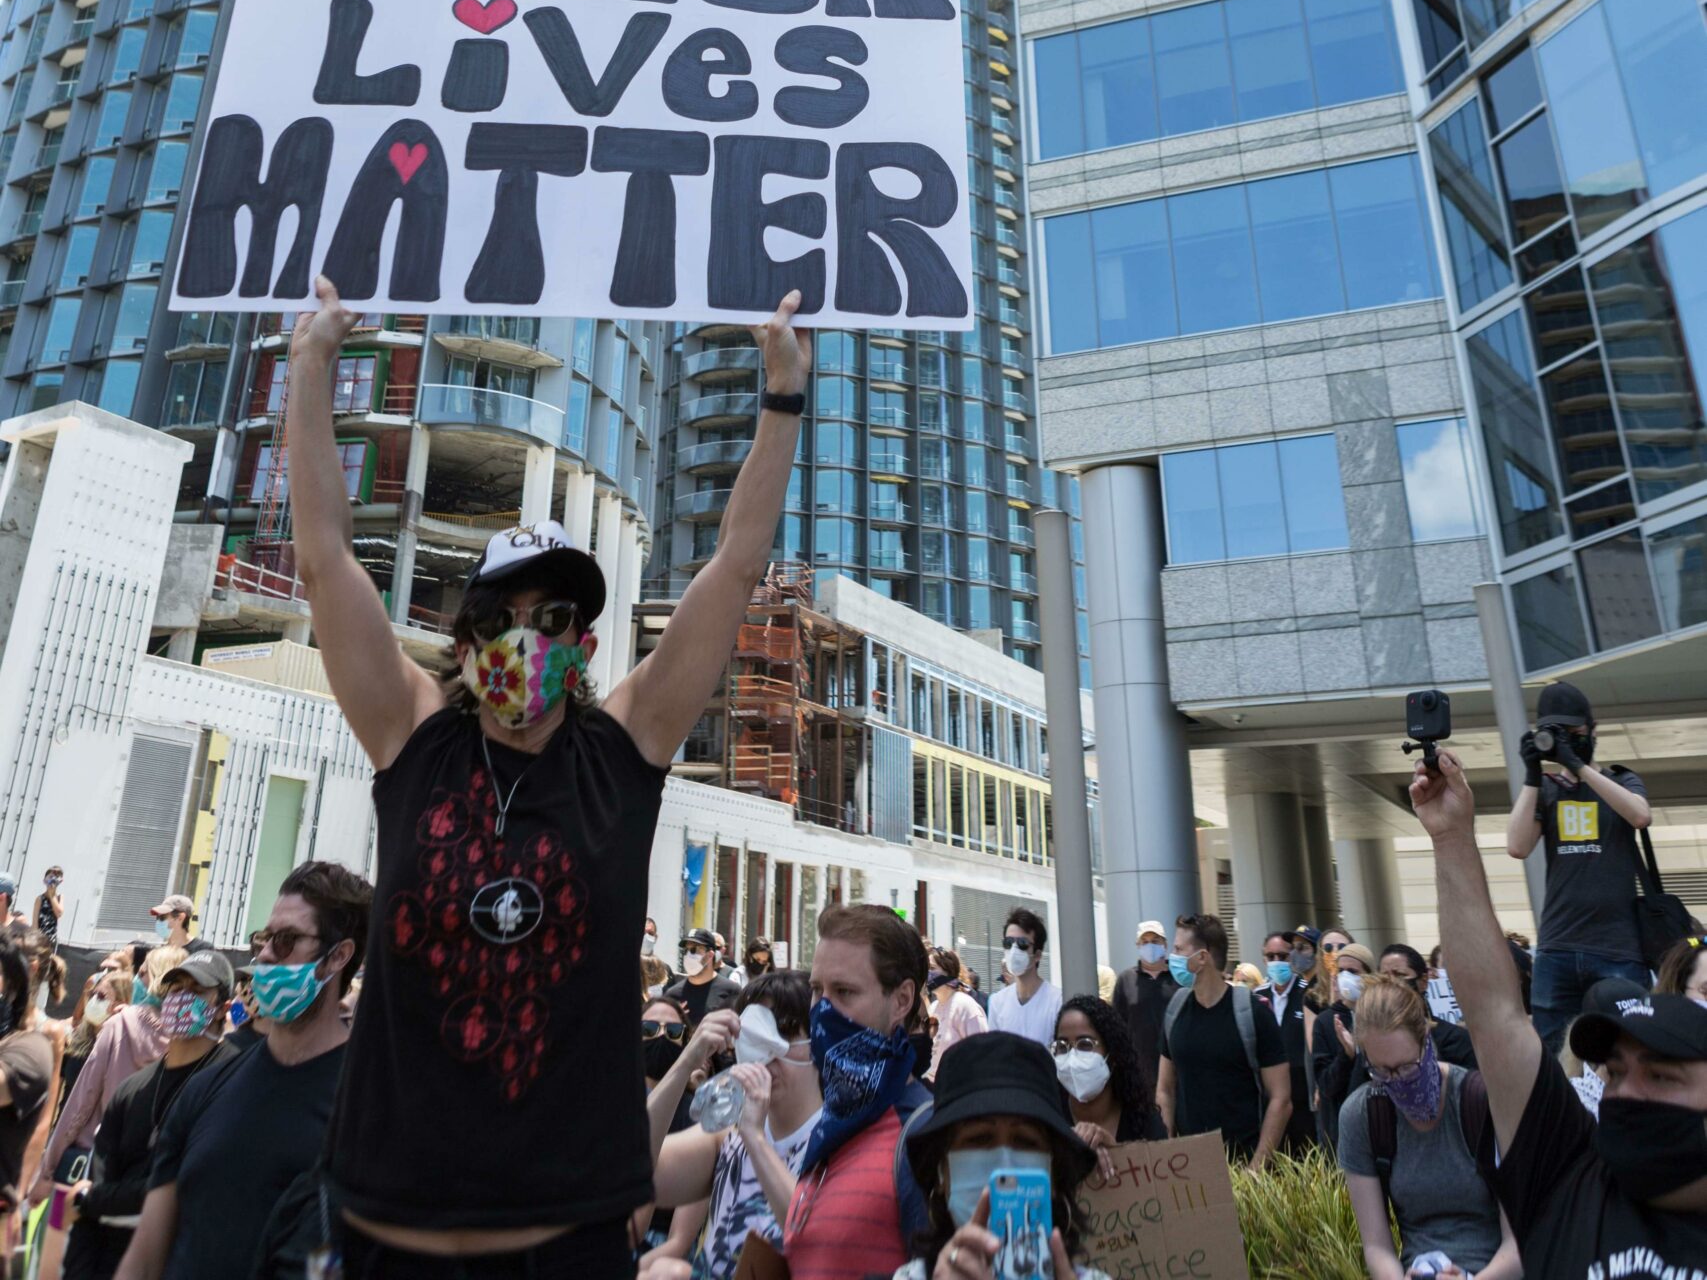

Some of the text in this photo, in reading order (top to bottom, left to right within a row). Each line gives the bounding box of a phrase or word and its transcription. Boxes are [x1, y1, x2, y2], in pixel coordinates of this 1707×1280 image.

[177, 113, 969, 318] MATTER
[1564, 805, 1592, 836] BE
[1096, 1230, 1138, 1253] #BLM
